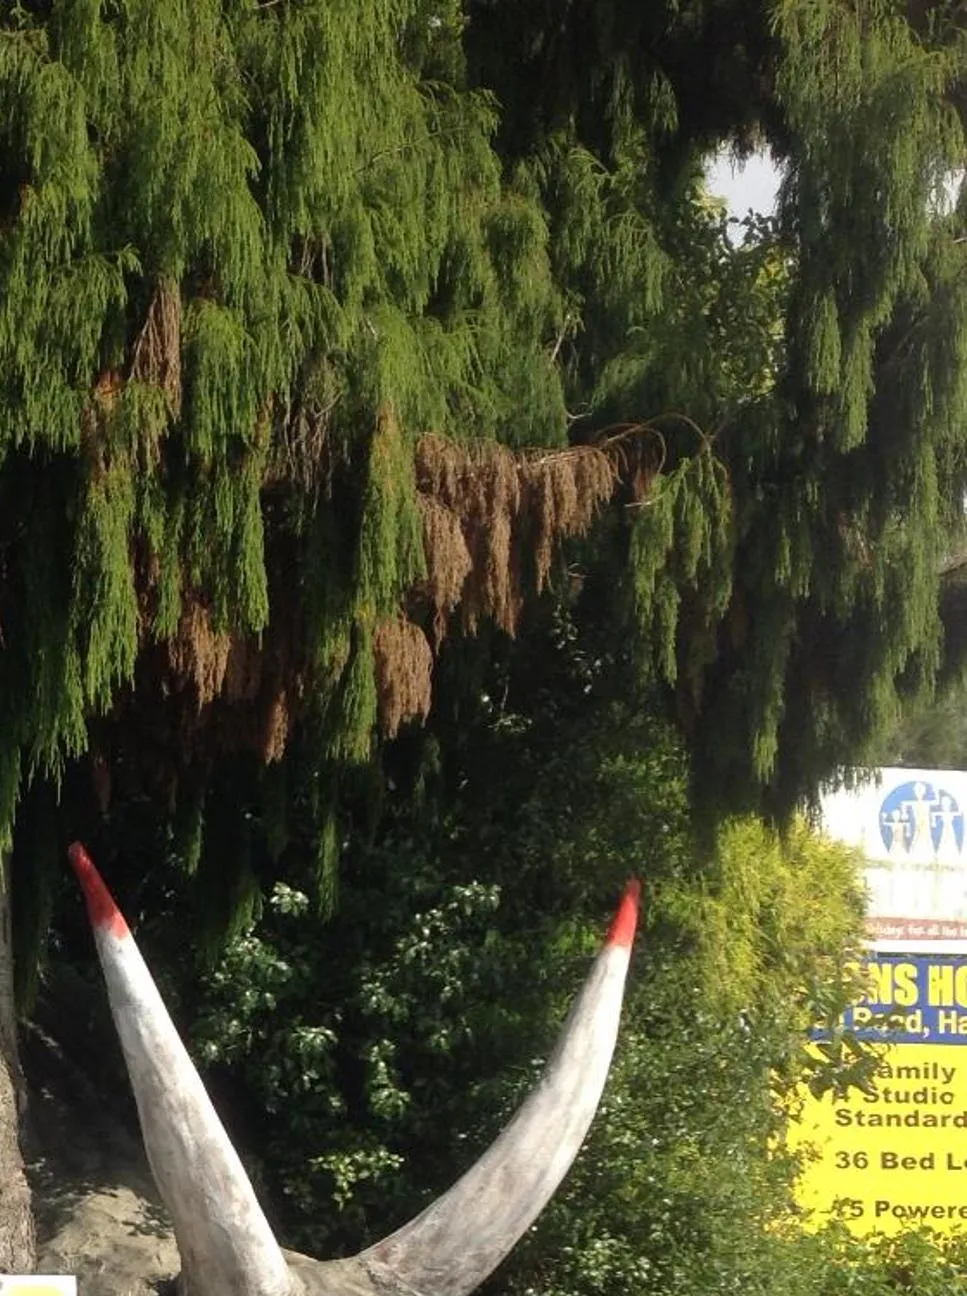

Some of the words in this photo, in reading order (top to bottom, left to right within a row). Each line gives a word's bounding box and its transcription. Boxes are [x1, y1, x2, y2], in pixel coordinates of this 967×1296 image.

[844, 961, 919, 1007] NS
[876, 1062, 956, 1084] amily
[863, 1085, 955, 1105] Studio
[835, 1108, 967, 1128] Standard
[835, 1151, 869, 1170] 36
[882, 1152, 935, 1170] Bed
[947, 1153, 967, 1171] L
